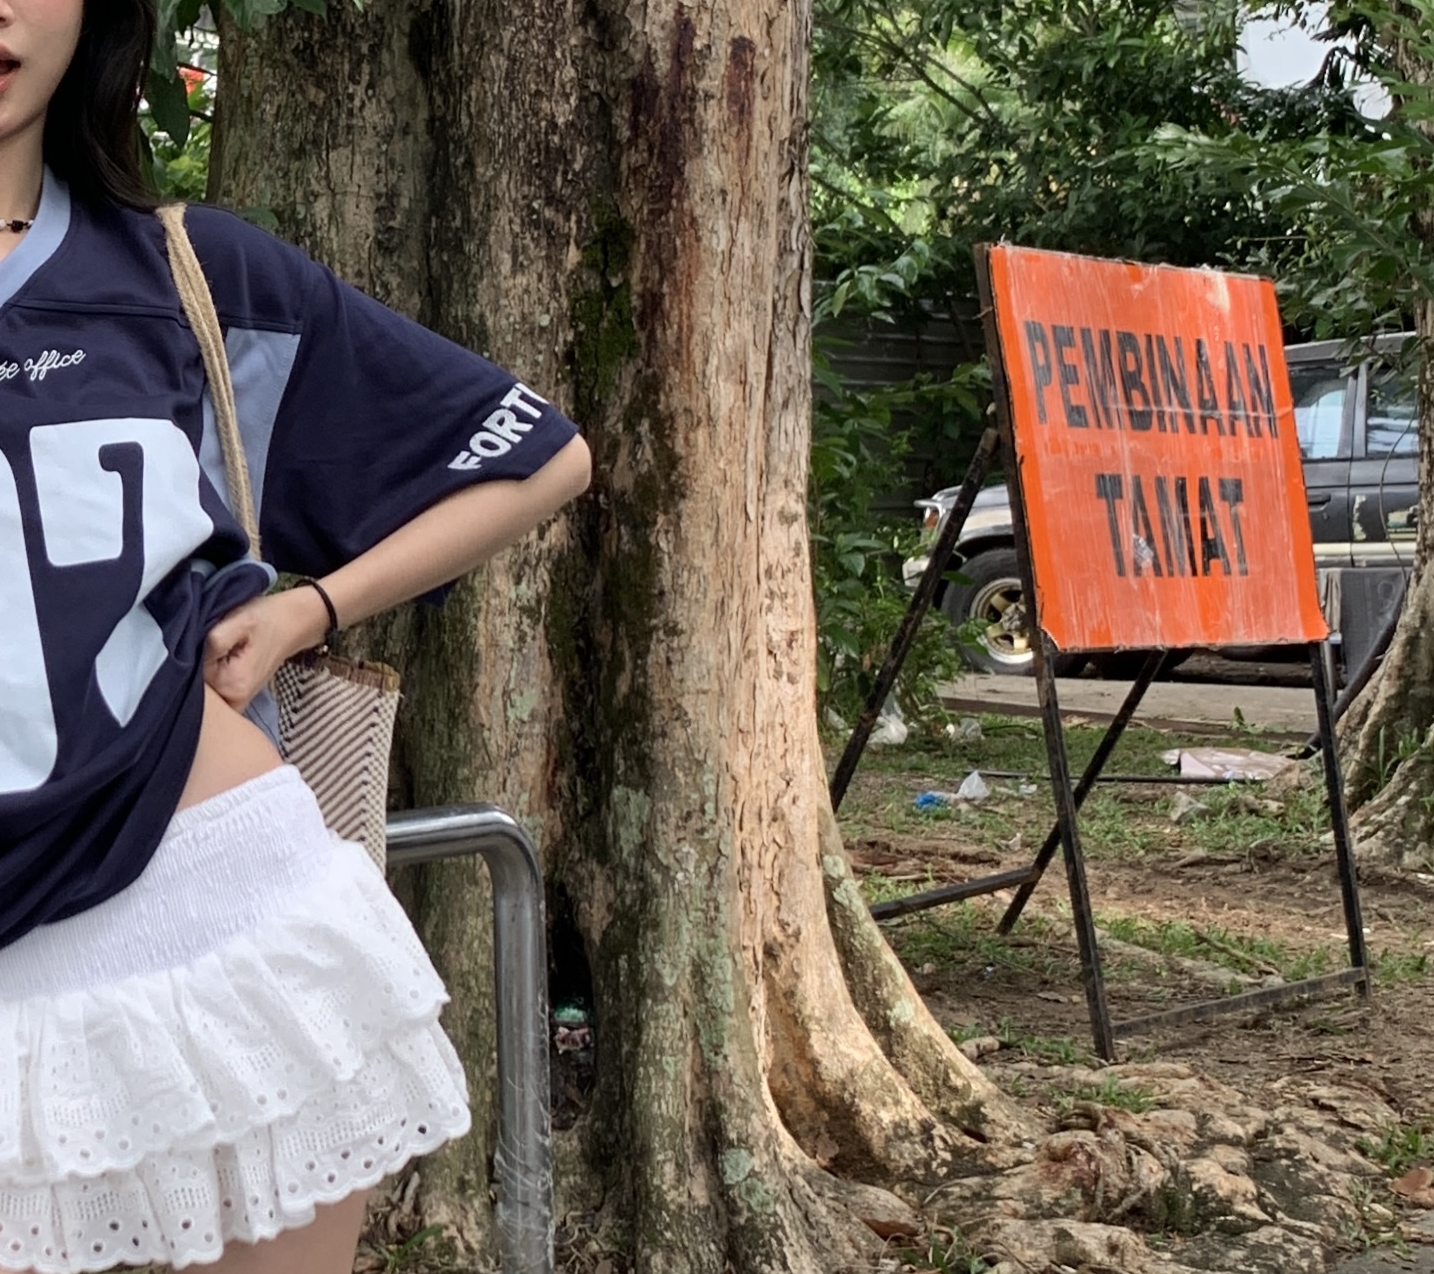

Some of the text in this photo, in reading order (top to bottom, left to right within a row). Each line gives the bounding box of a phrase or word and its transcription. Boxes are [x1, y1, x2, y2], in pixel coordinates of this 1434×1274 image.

[23, 349, 87, 382] office
[1022, 319, 1279, 439] PEMBINAAN
[447, 381, 550, 471] FORT
[1095, 471, 1248, 578] TAMAT
